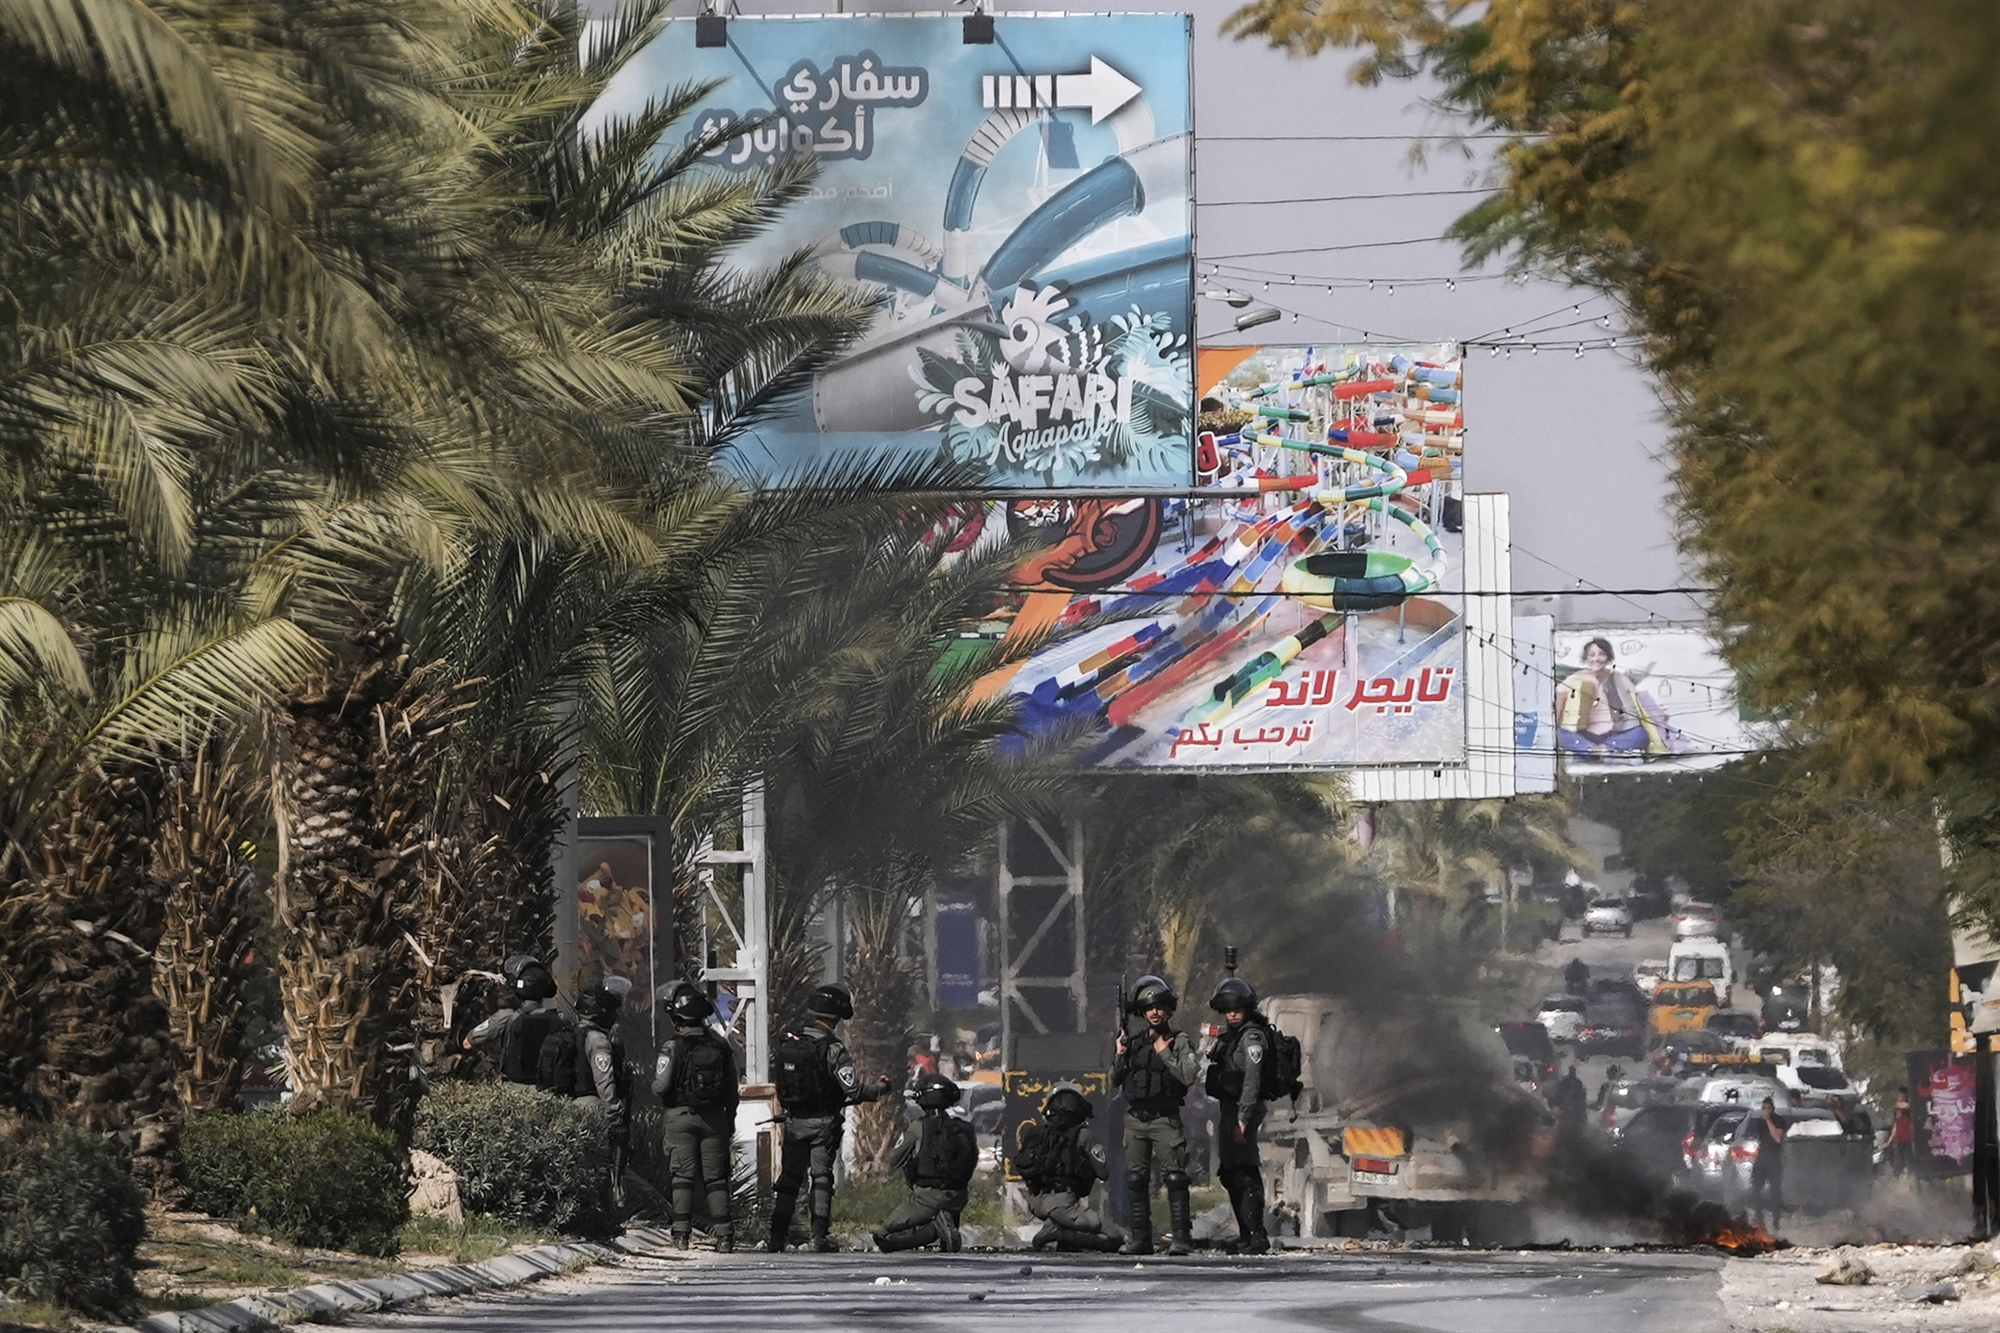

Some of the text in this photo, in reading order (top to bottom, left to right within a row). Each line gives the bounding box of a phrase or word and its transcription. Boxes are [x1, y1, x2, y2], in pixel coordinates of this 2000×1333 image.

[783, 58, 920, 114] سفاري
[953, 373, 1133, 430] SAFARI
[986, 417, 1114, 465] Aquapark
[1265, 667, 1453, 713] تايجر لاند
[1168, 719, 1314, 759] ترحب بكم
